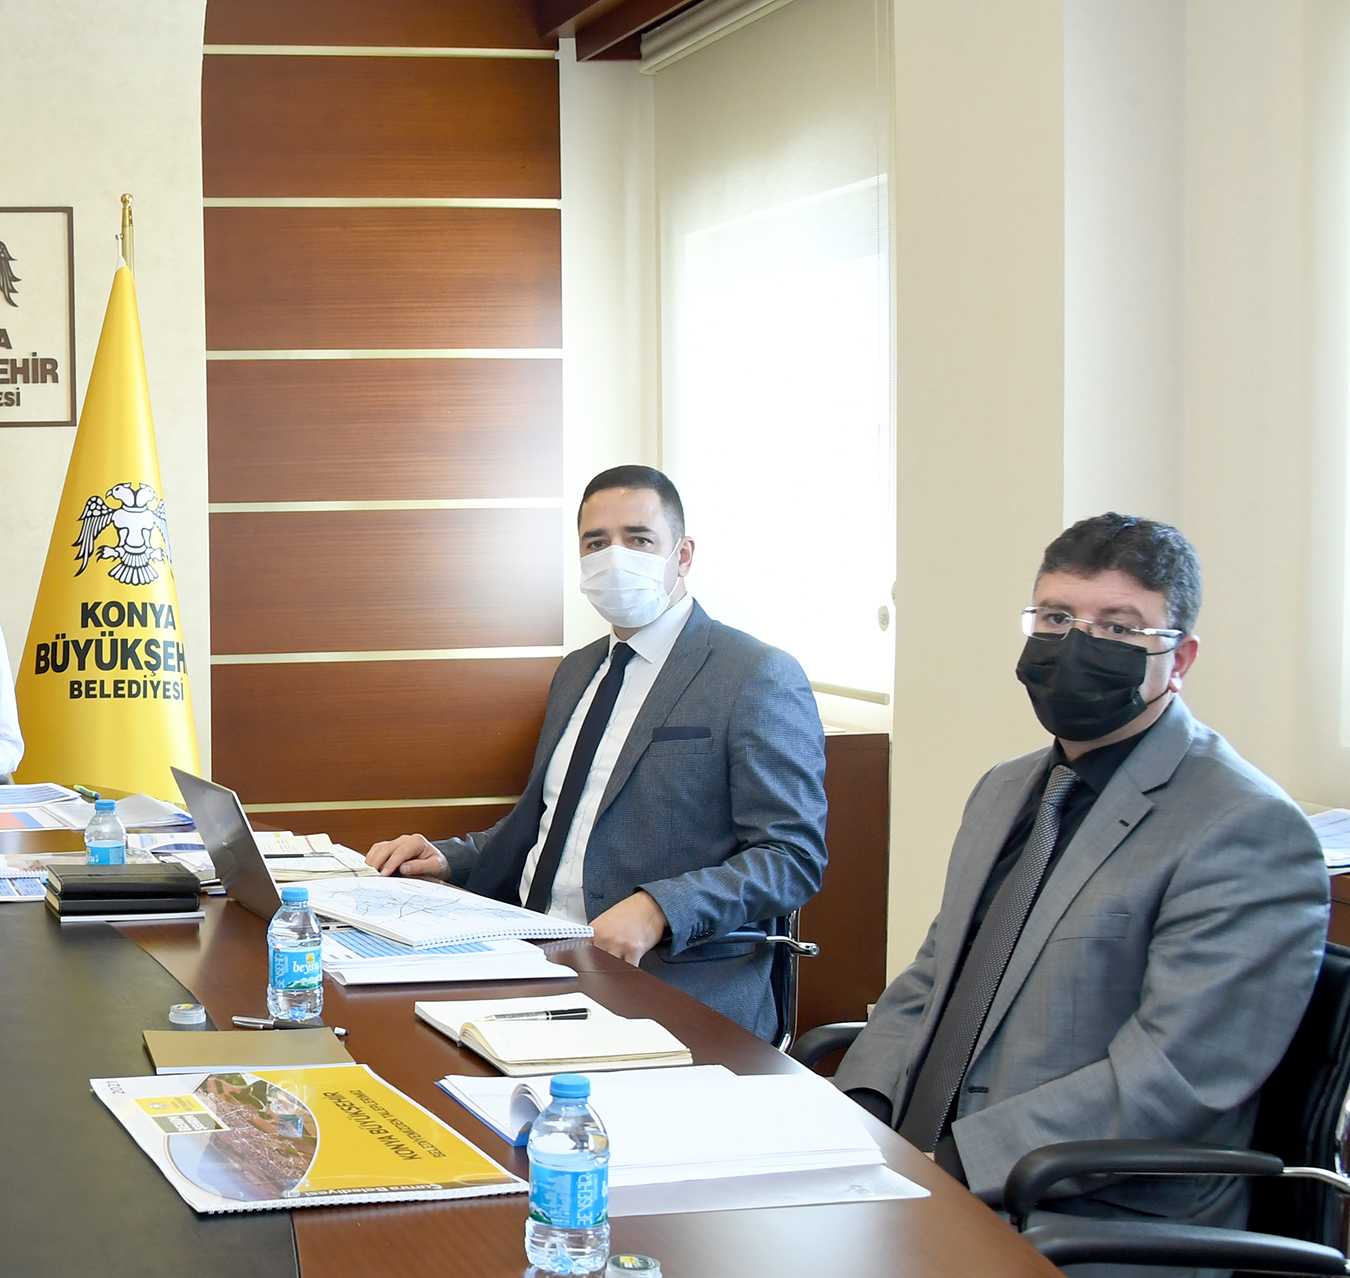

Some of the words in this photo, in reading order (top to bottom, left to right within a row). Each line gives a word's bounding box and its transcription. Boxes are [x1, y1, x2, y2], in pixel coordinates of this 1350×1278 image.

[80, 600, 177, 630] KONYA
[69, 675, 185, 701] BELEDİYESİ
[323, 1090, 390, 1136] BÜYÜKŞEHİR
[377, 1134, 422, 1161] KONYA
